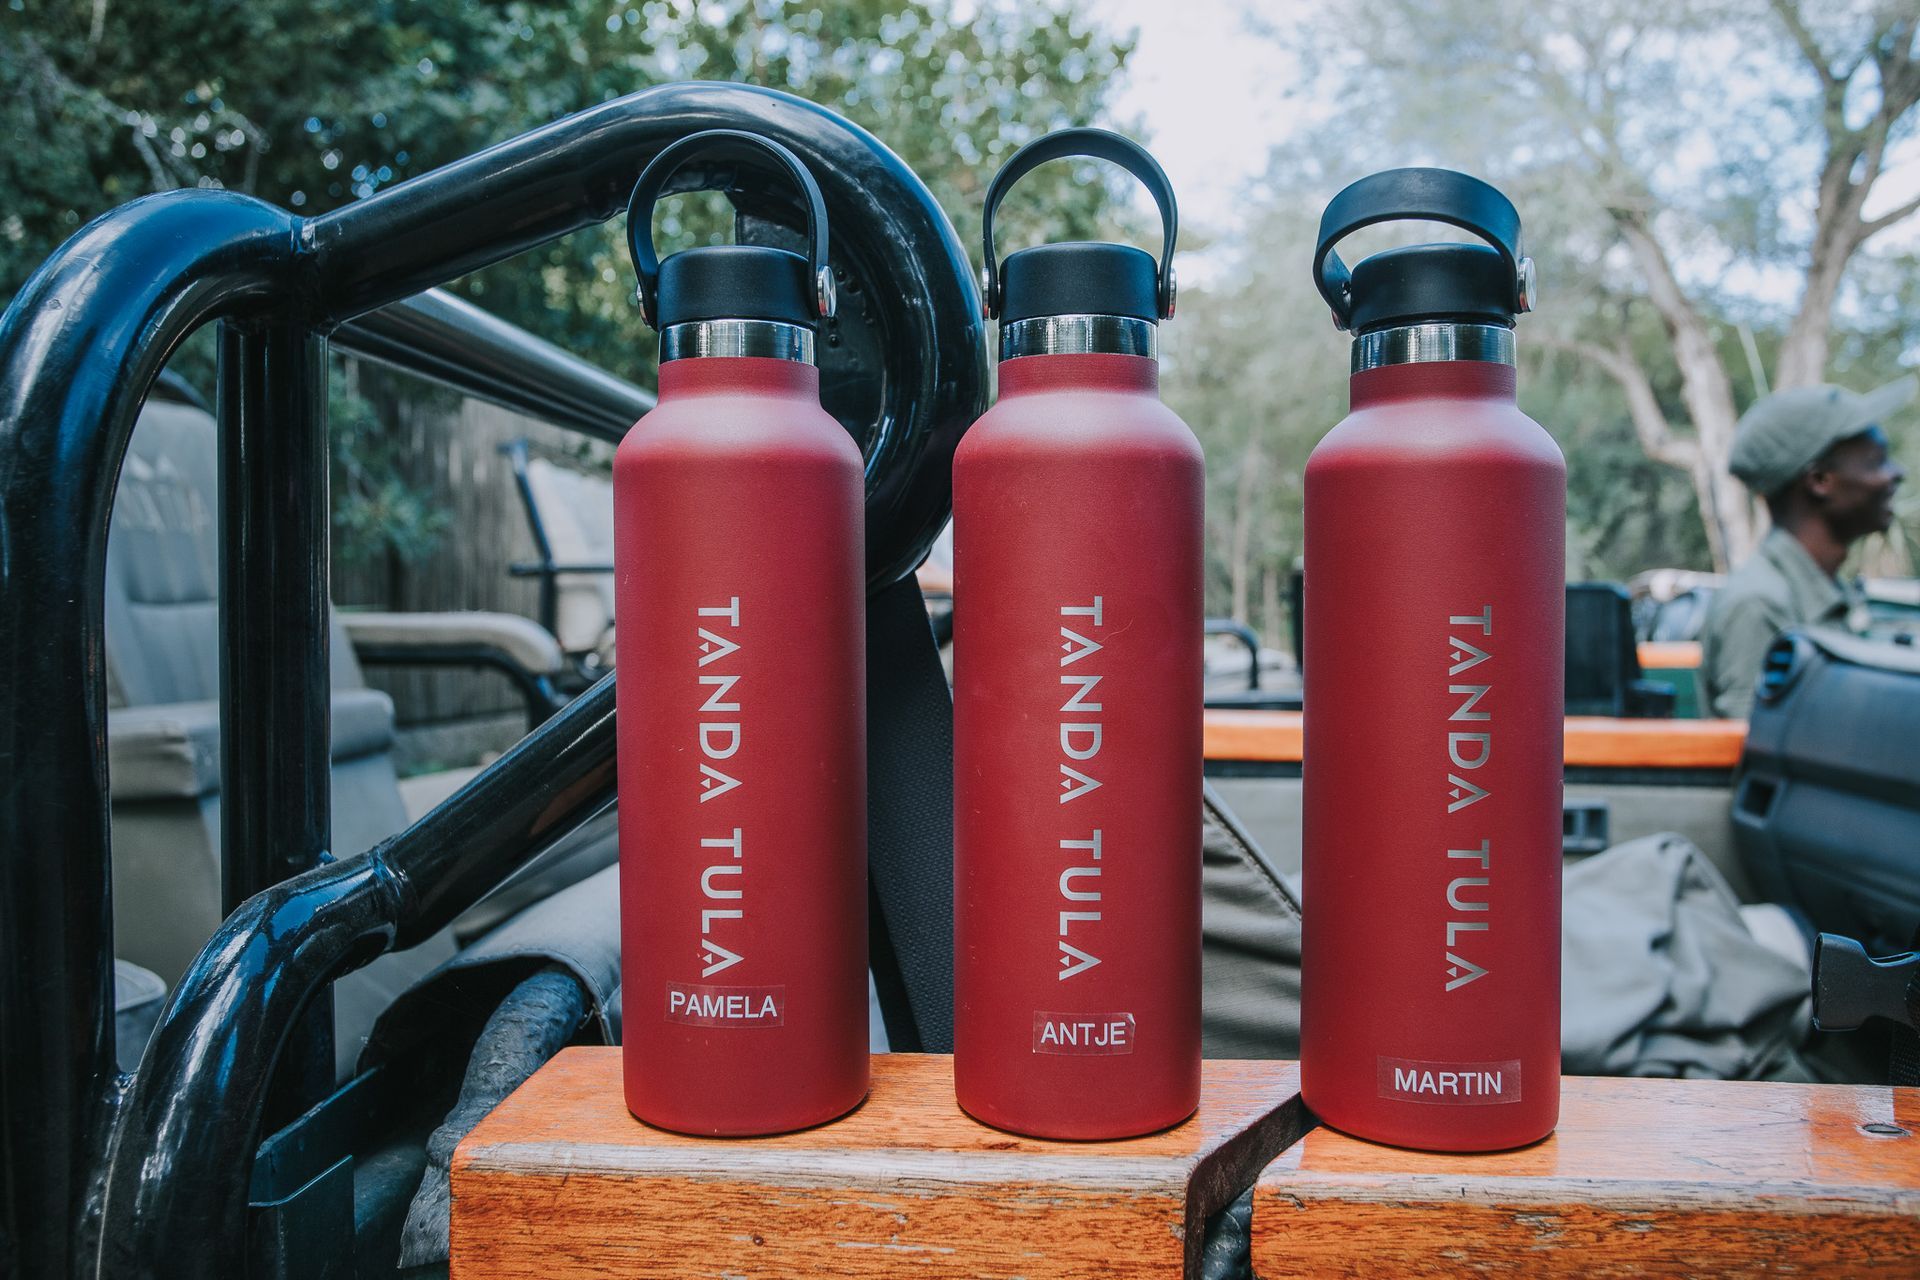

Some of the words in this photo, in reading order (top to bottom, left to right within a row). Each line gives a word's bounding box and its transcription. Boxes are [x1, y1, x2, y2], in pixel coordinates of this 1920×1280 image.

[697, 596, 743, 804] TANDA
[1060, 595, 1104, 804] TANDA
[1447, 605, 1492, 814] TANDA
[700, 827, 745, 979] TULA
[1058, 829, 1102, 981] TULA
[1445, 839, 1489, 992] TULA
[669, 990, 778, 1019] PAMELA
[1040, 1021, 1126, 1047] ANTJE
[1394, 1067, 1502, 1096] MARTIN
